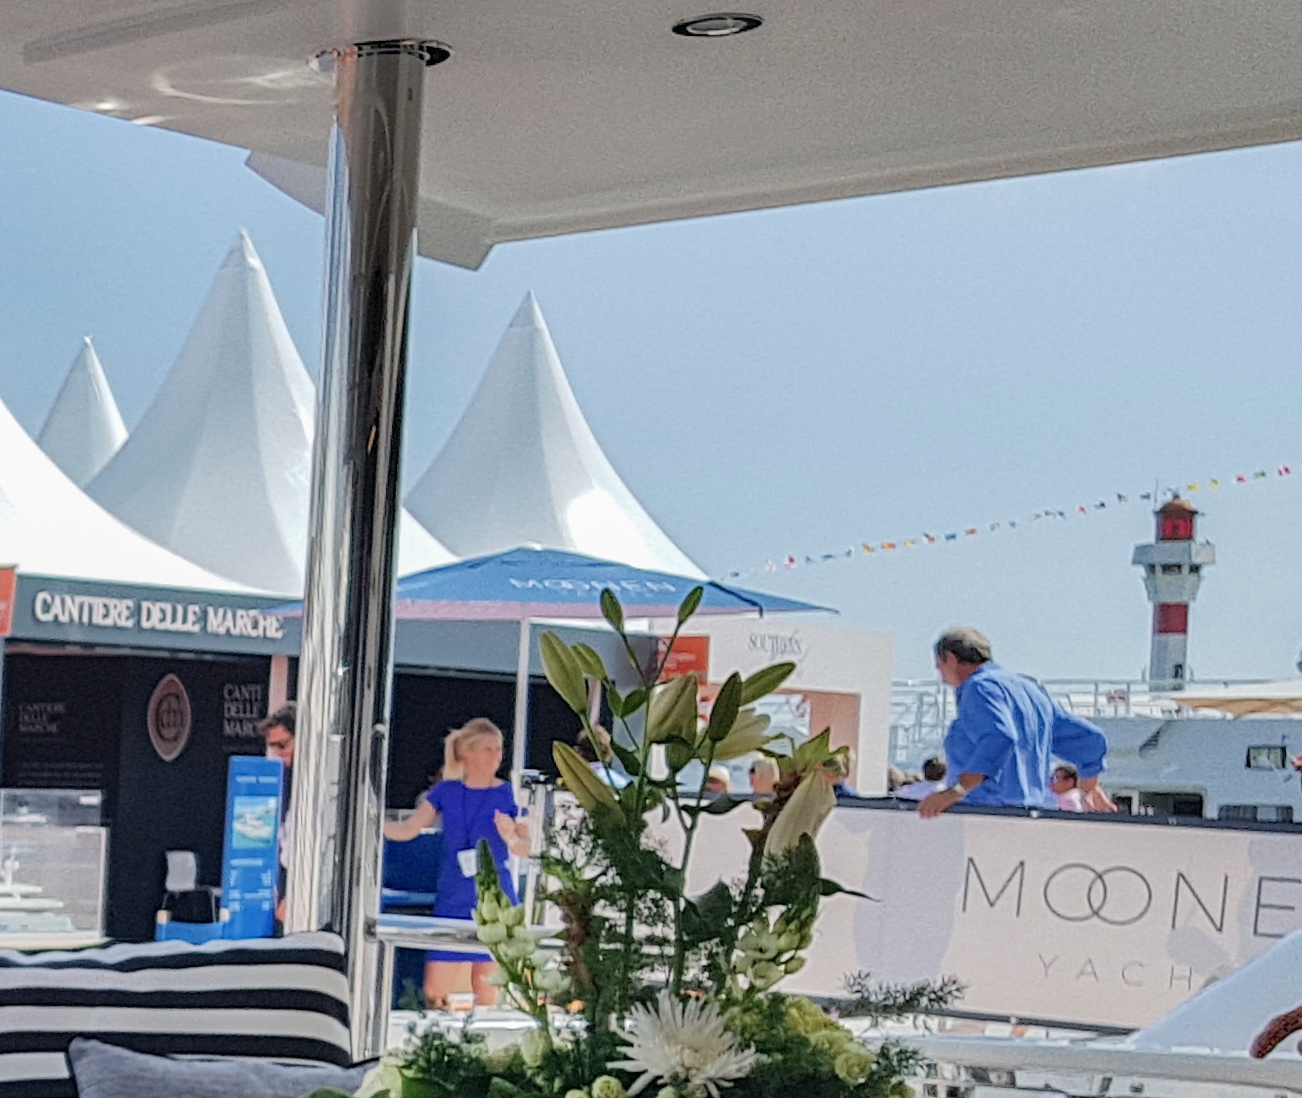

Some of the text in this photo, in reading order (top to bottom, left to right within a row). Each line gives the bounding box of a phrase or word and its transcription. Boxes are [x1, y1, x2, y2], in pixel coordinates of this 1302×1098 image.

[33, 589, 286, 640] CANTIERE DELLE MARCHE
[222, 682, 264, 701] CANTI
[223, 701, 259, 719] DELLE
[222, 719, 259, 737] MARC
[961, 855, 1302, 938] MOONE
[1038, 951, 1195, 992] YACH
